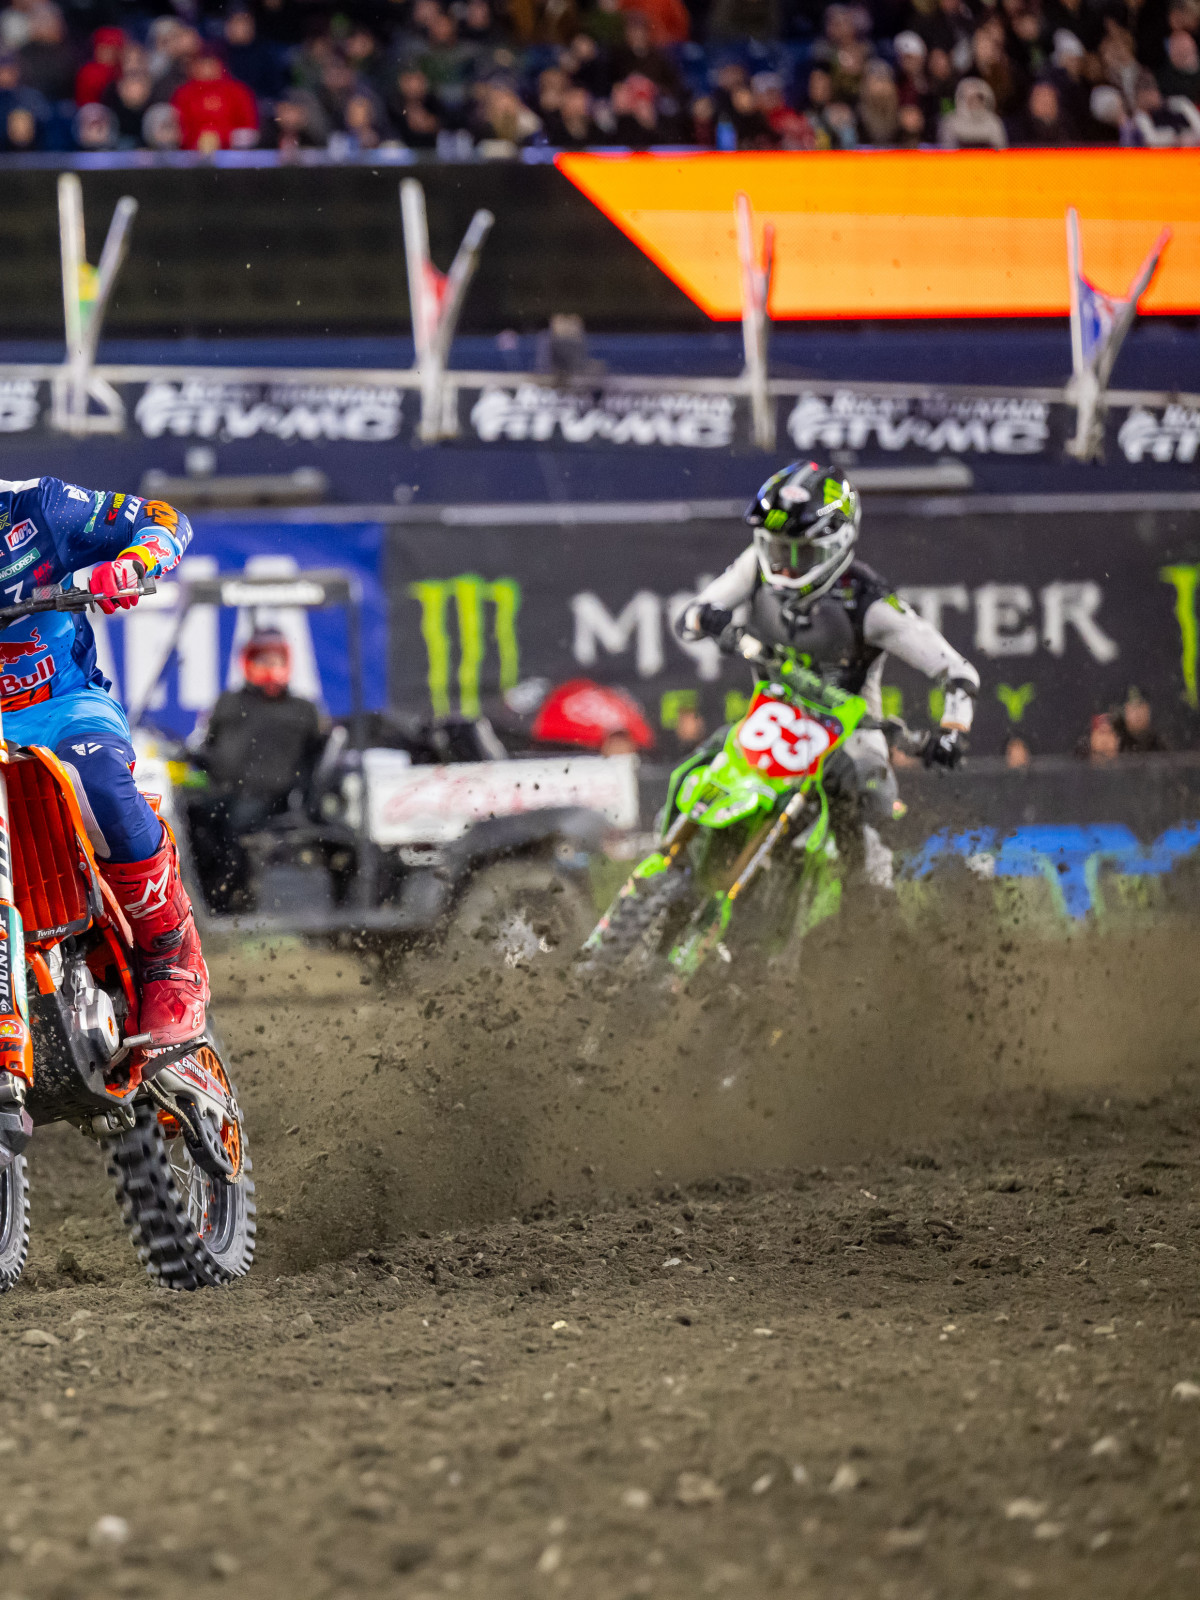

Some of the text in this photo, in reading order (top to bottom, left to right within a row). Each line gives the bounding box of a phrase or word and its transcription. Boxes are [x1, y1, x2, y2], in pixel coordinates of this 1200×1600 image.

[10, 524, 33, 548] 100%
[0, 655, 55, 696] Bull
[738, 701, 831, 772] 63
[37, 926, 68, 938] Twin Air
[182, 1057, 207, 1083] ENTHAL
